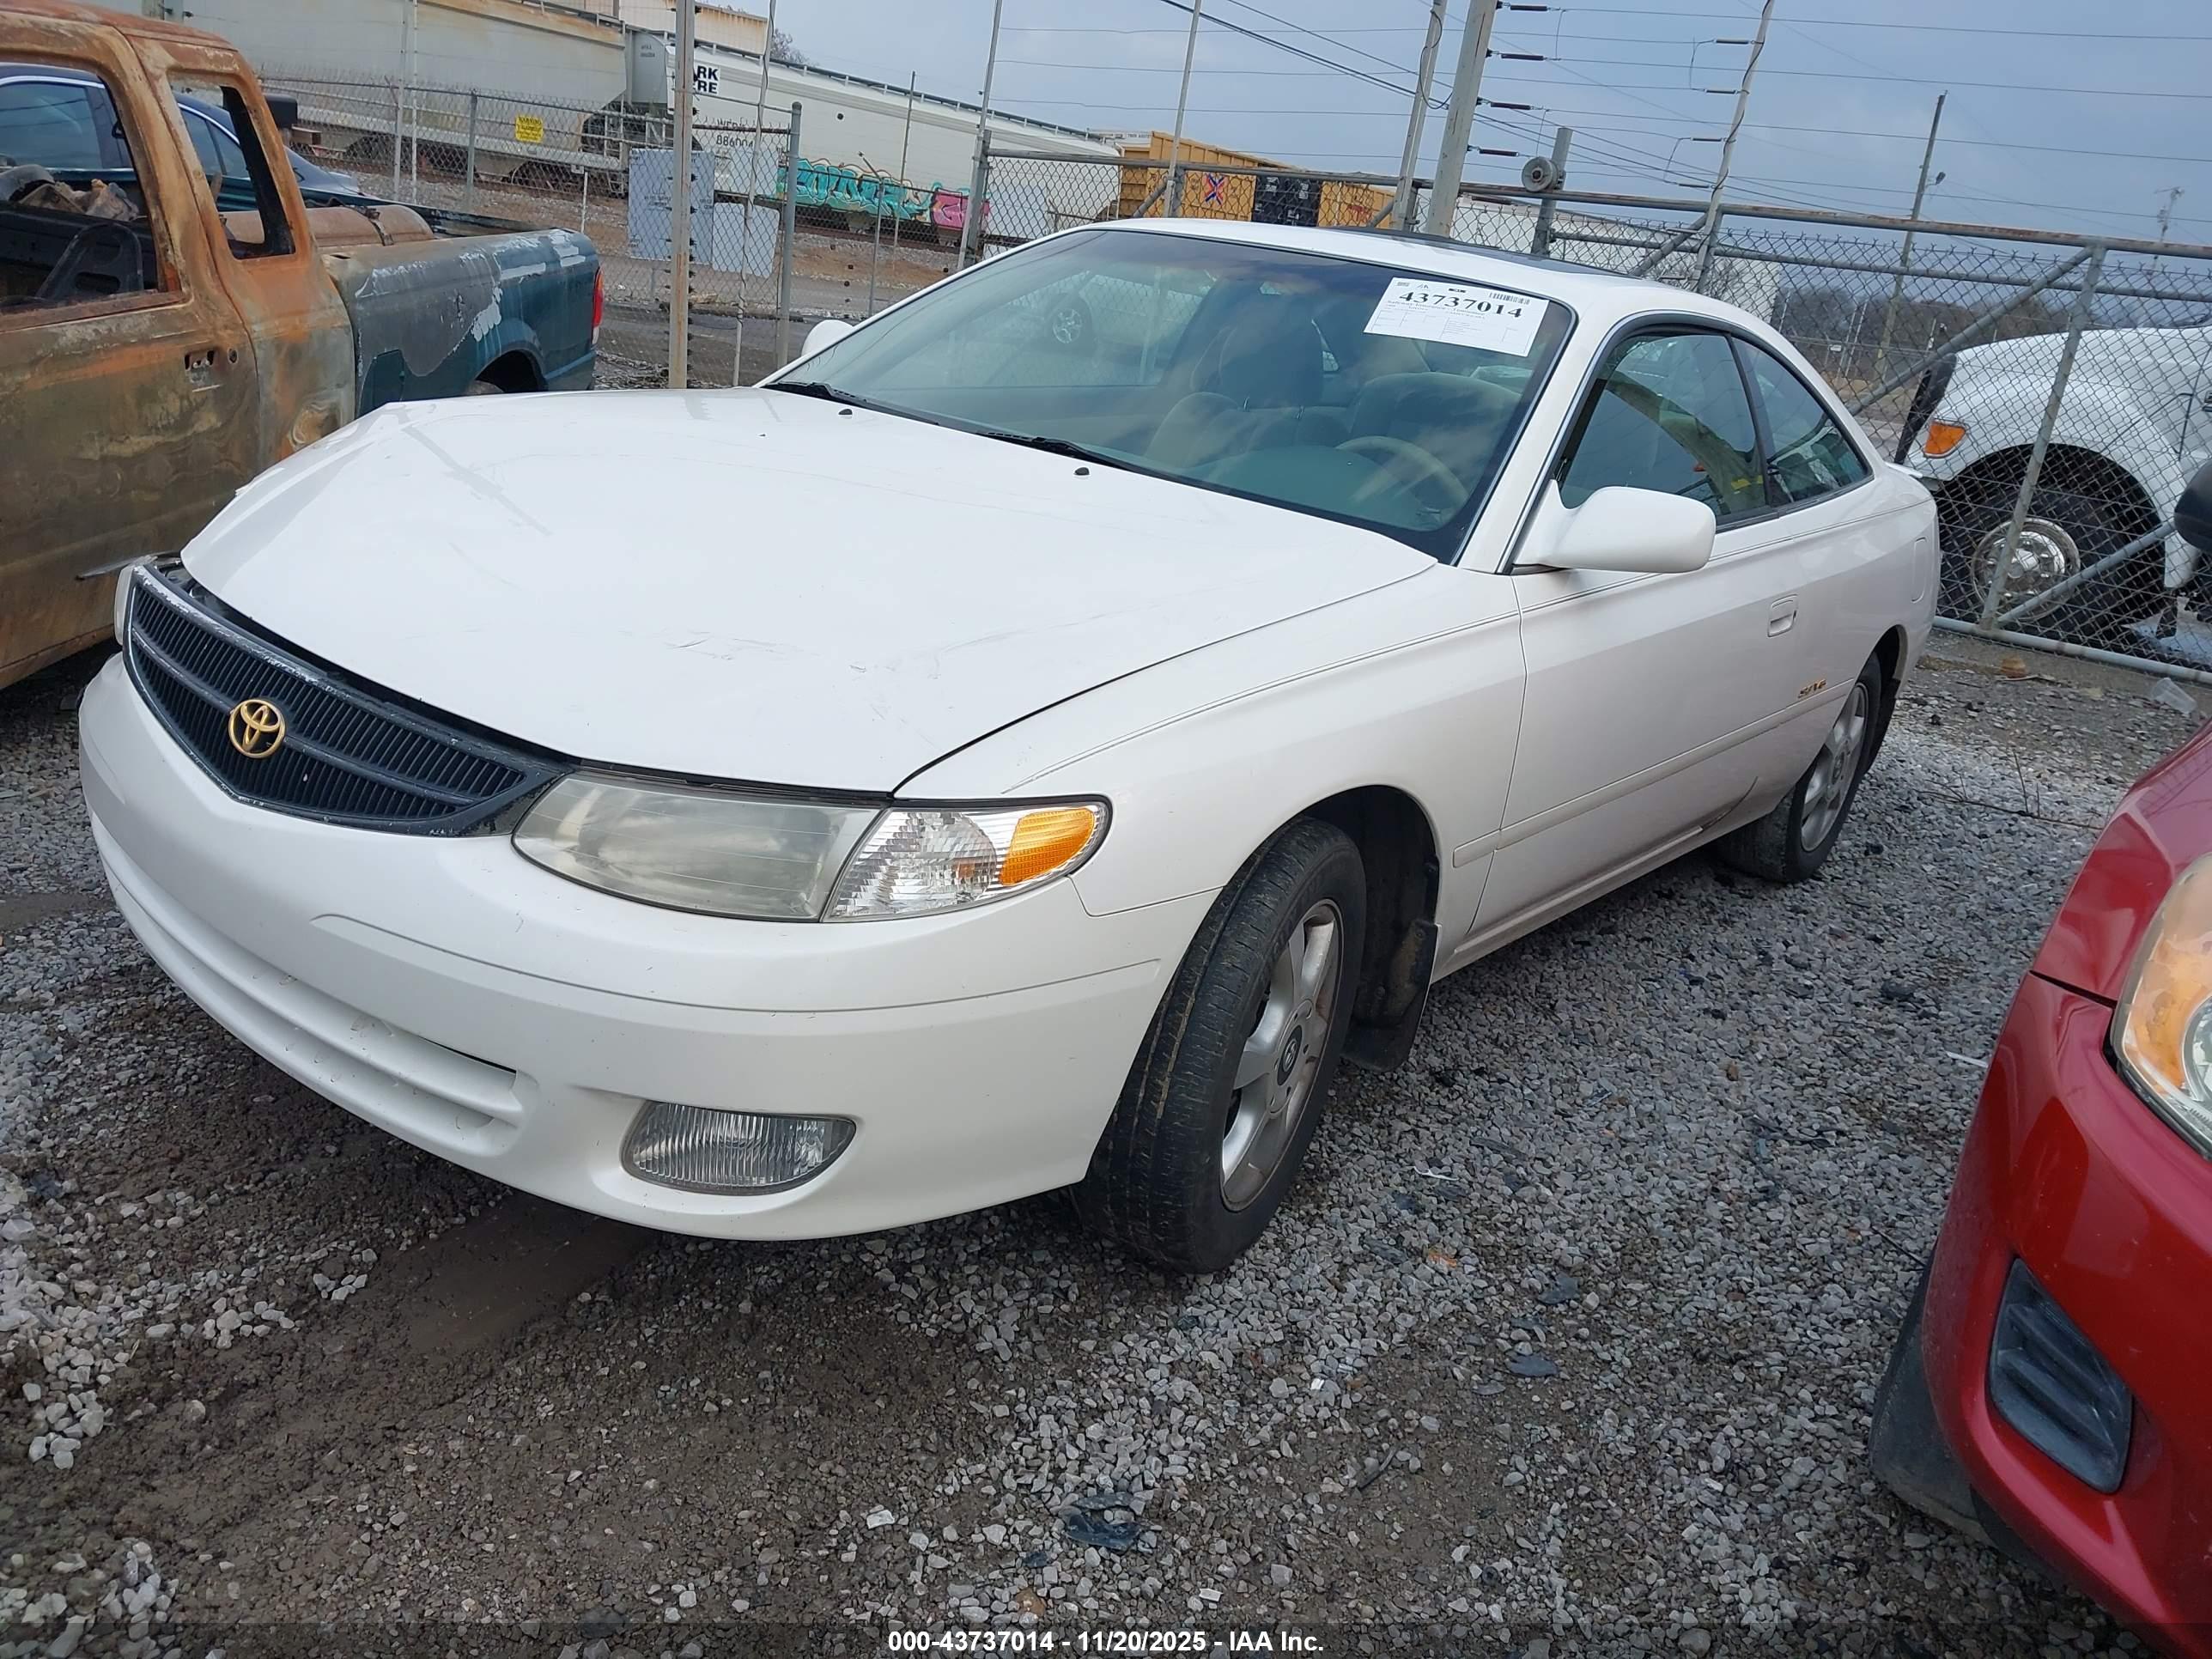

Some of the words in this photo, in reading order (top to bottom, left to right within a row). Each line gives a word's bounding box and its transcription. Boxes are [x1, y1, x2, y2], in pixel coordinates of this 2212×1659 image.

[694, 65, 719, 82] RK
[693, 80, 718, 94] RE
[1399, 291, 1522, 319] 43737014
